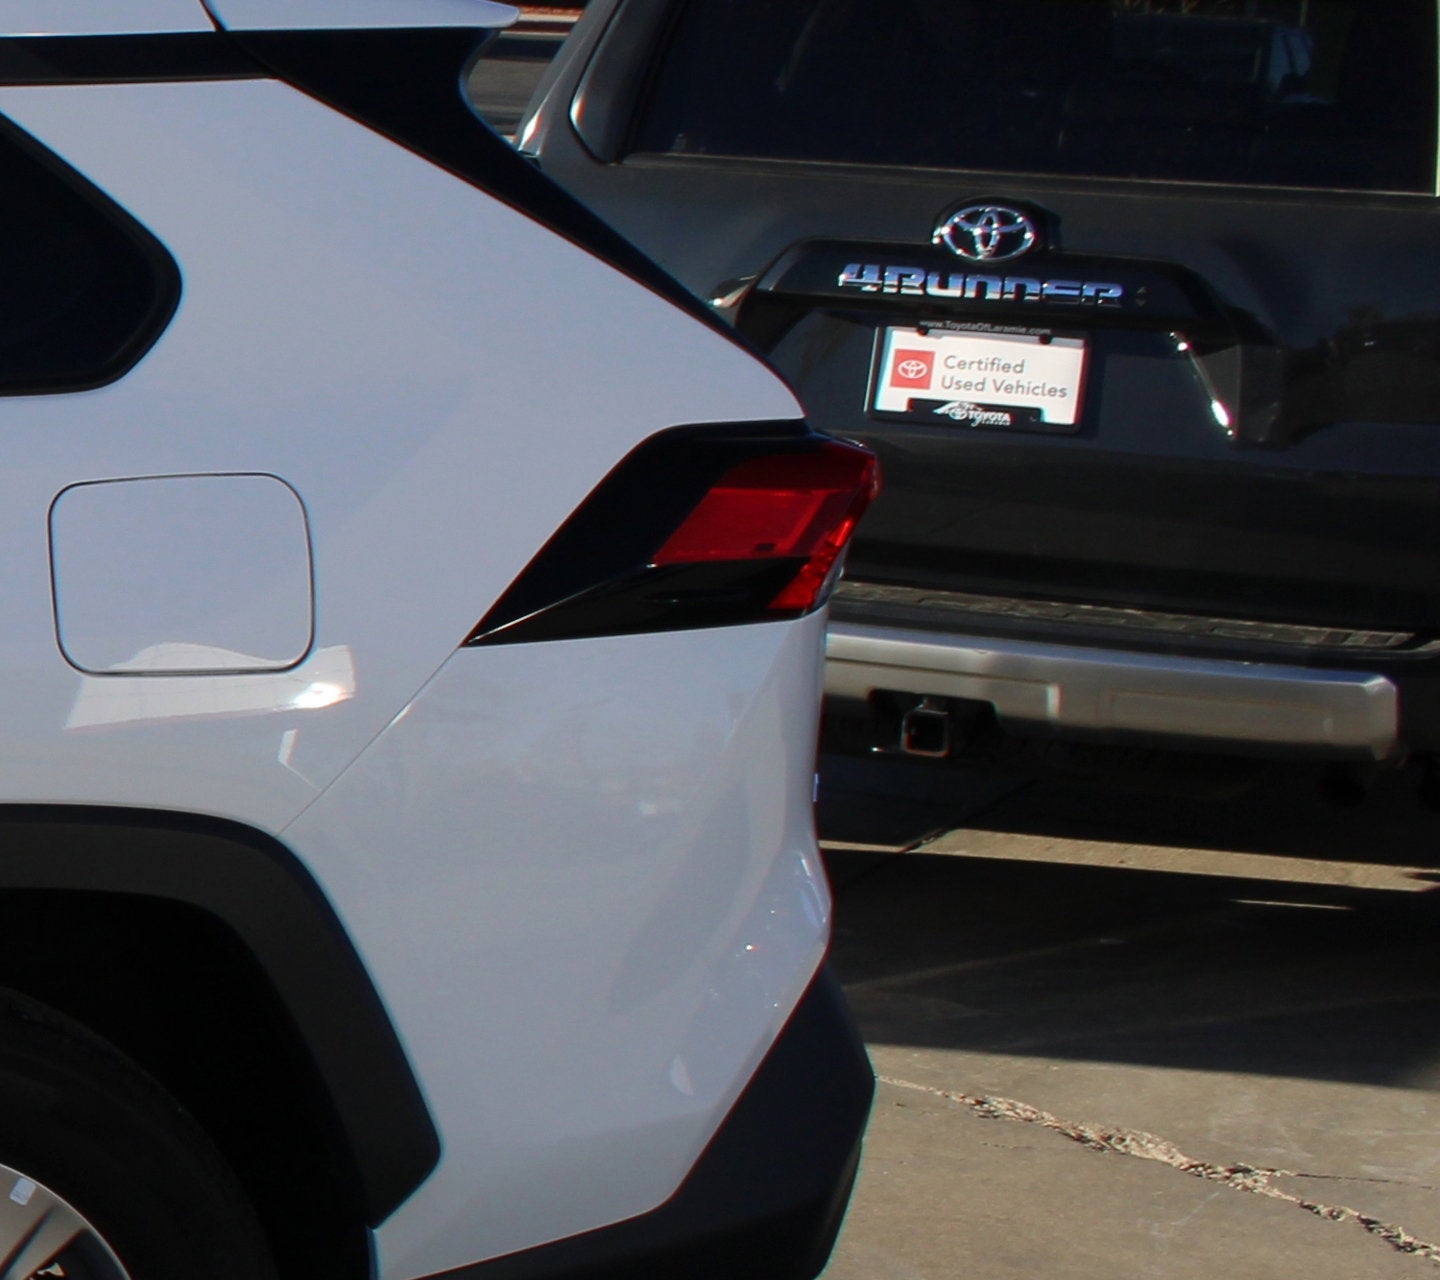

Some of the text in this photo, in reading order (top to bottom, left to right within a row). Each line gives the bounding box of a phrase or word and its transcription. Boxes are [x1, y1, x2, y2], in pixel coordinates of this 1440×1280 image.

[838, 263, 1124, 307] 4RUNNER
[918, 319, 1052, 336] www.ToyotaOfLaramie.com
[943, 354, 1025, 374] Certified
[941, 374, 1068, 399] Used Vehicles
[968, 410, 1012, 422] TOYOTA
